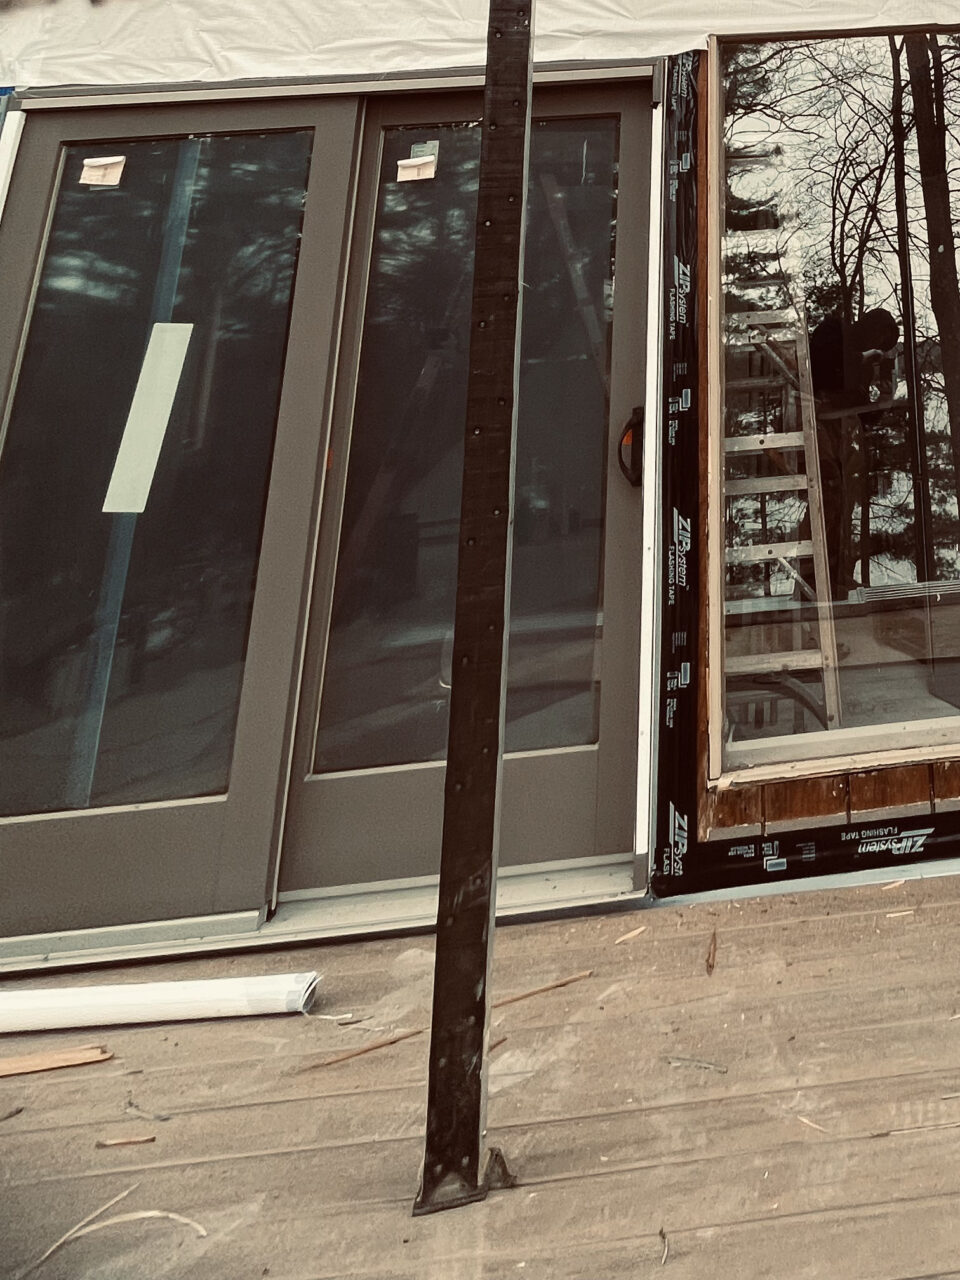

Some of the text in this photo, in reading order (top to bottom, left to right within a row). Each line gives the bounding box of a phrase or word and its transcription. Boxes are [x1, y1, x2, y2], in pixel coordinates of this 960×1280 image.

[670, 96, 678, 111] TAPE
[841, 826, 898, 841] FLASHING TAPE
